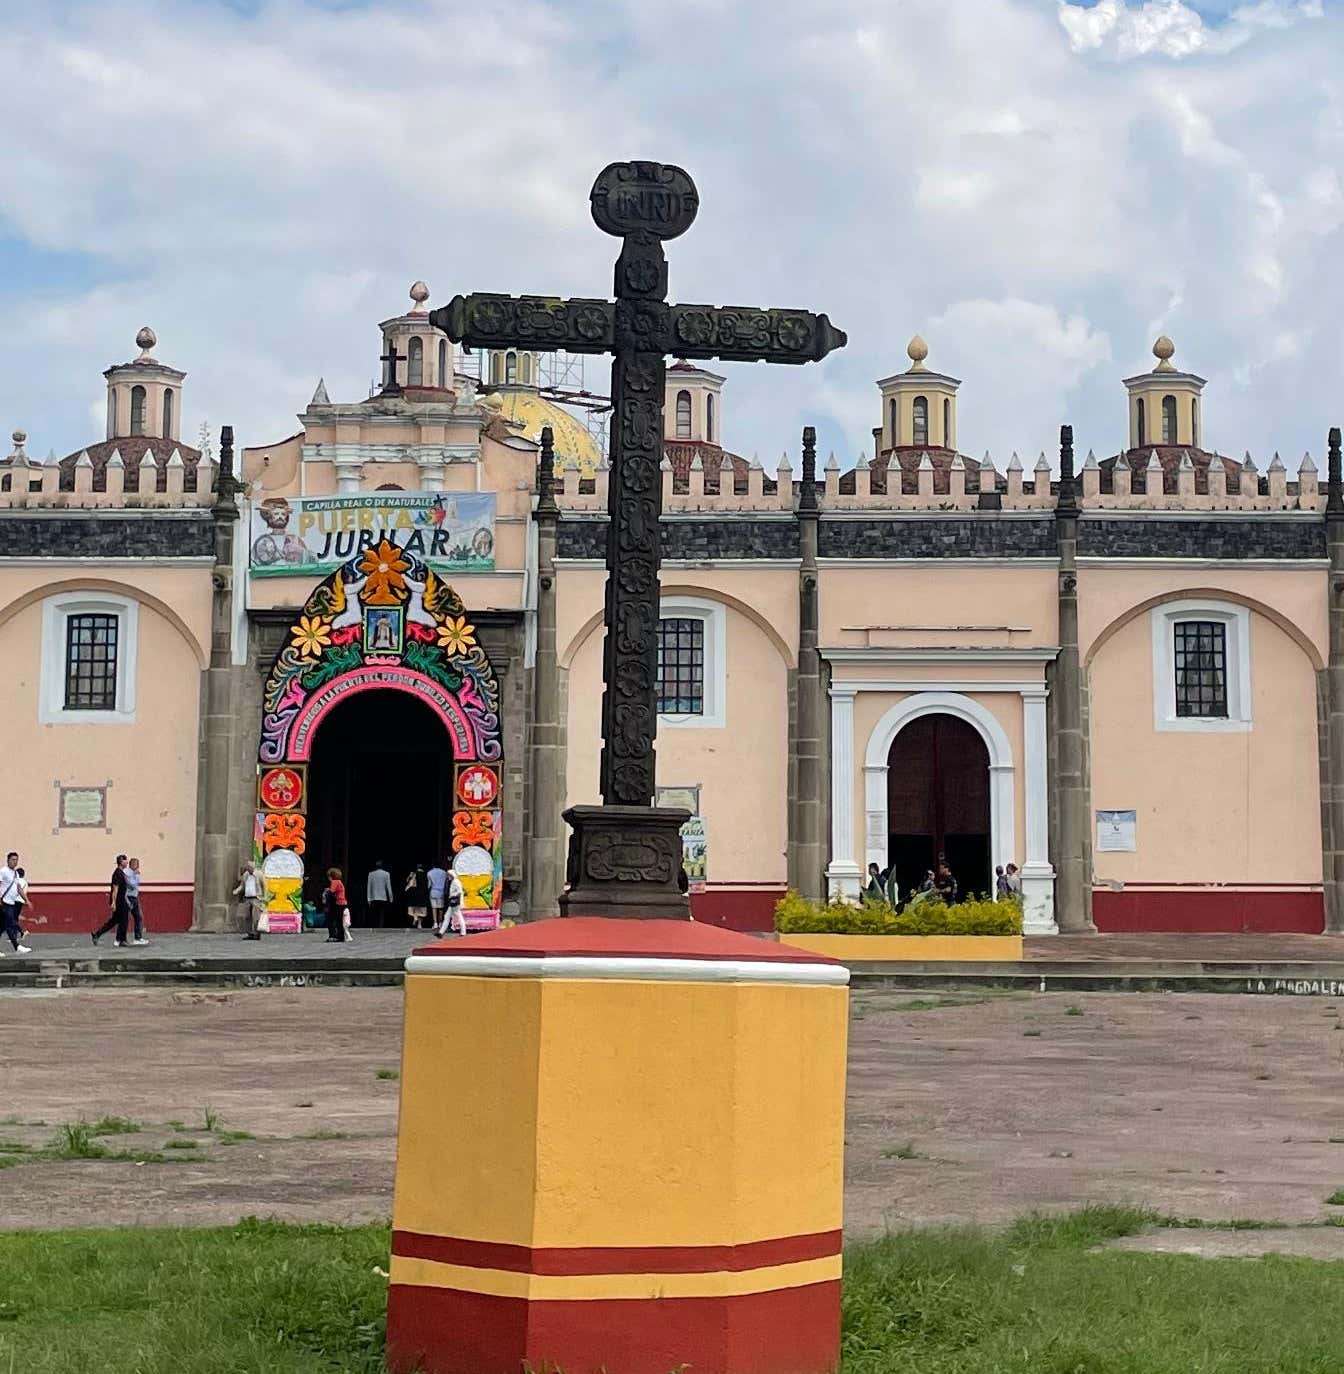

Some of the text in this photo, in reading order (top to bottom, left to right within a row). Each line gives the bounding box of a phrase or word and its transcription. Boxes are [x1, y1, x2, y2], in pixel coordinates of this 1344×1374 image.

[306, 497, 434, 511] CAPILLA REAL O DE NATURALES
[299, 508, 415, 537] PUERTA
